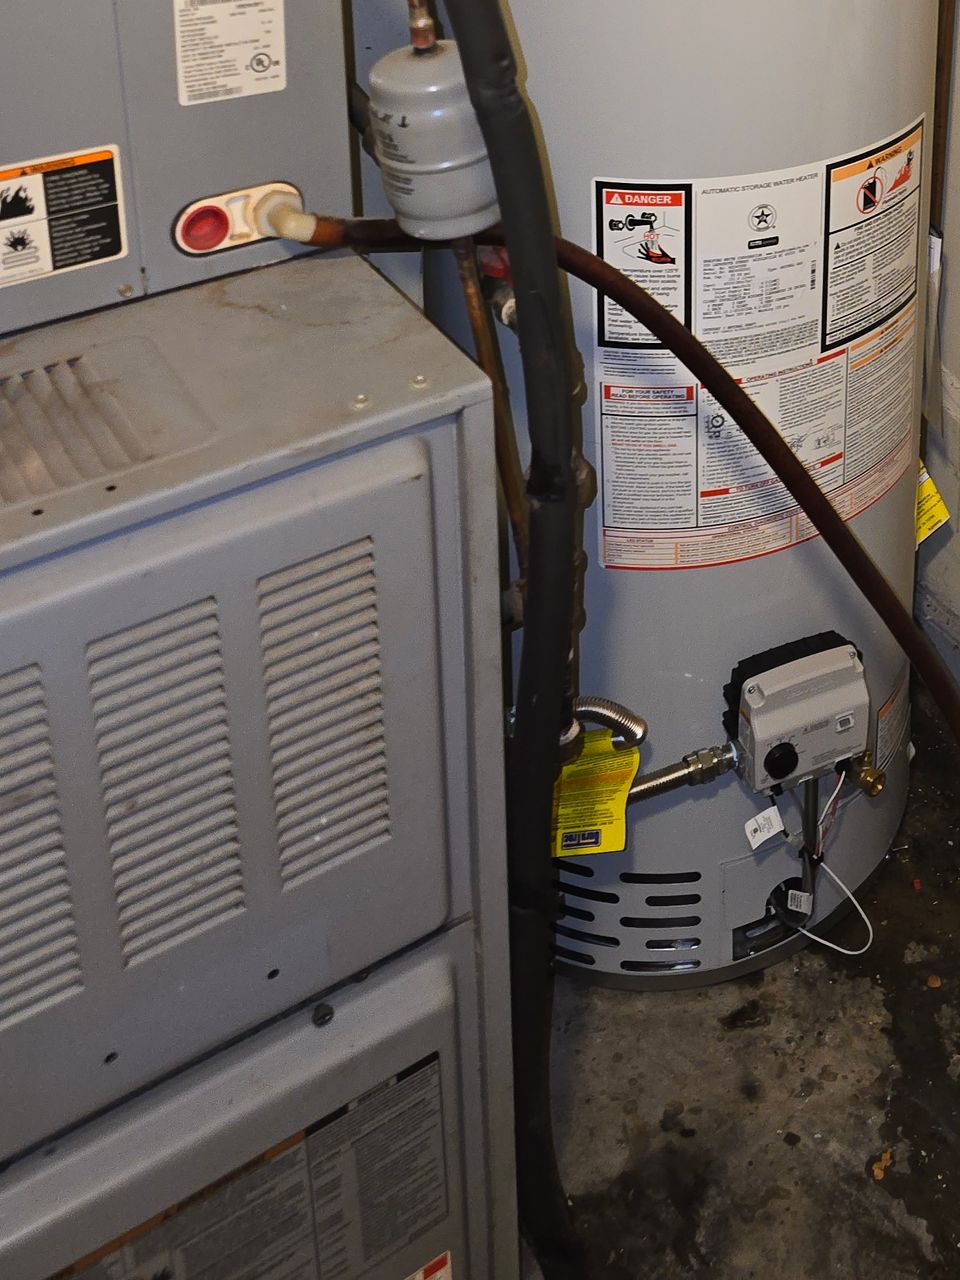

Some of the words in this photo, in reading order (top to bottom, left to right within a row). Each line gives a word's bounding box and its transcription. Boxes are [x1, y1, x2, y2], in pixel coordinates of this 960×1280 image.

[701, 186, 740, 195] AUTOMATIC
[741, 181, 772, 192] STORAGE
[773, 177, 795, 187] WATER
[795, 172, 819, 182] HEATER
[624, 194, 672, 205] DANGER
[643, 232, 661, 240] HOT
[745, 371, 778, 383] OPERATING
[778, 361, 813, 376] INSTRUCTIONS
